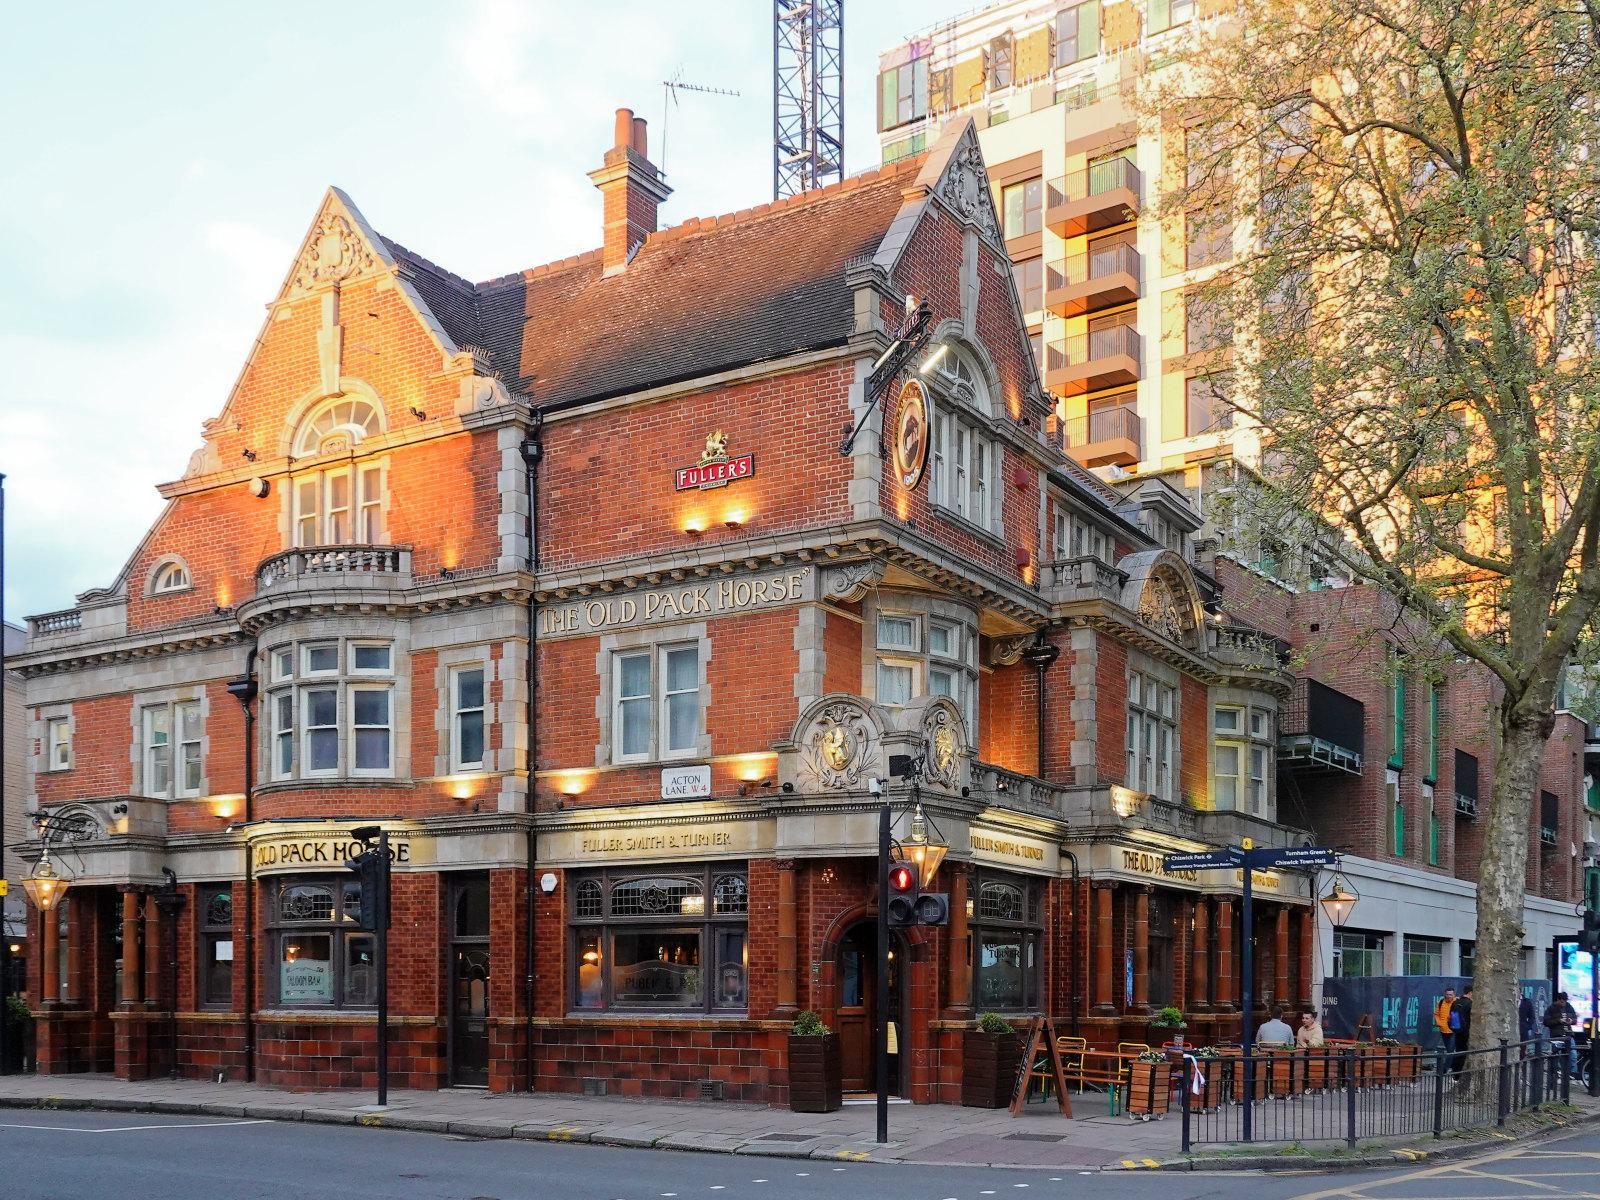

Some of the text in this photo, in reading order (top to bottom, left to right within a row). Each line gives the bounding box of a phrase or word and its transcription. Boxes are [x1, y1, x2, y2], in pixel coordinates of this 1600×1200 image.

[680, 460, 747, 486] FULLER'S
[538, 606, 580, 635] THE
[644, 587, 712, 620] PACK
[671, 775, 701, 785] ACTON
[280, 842, 328, 863] PACK
[582, 832, 732, 853] FULLER SMITH & TURNER
[970, 836, 993, 851] FULLER
[994, 840, 1014, 855] SMITH
[1021, 845, 1044, 861] TURNER
[1122, 850, 1139, 872] THE
[1140, 853, 1154, 875] OLD
